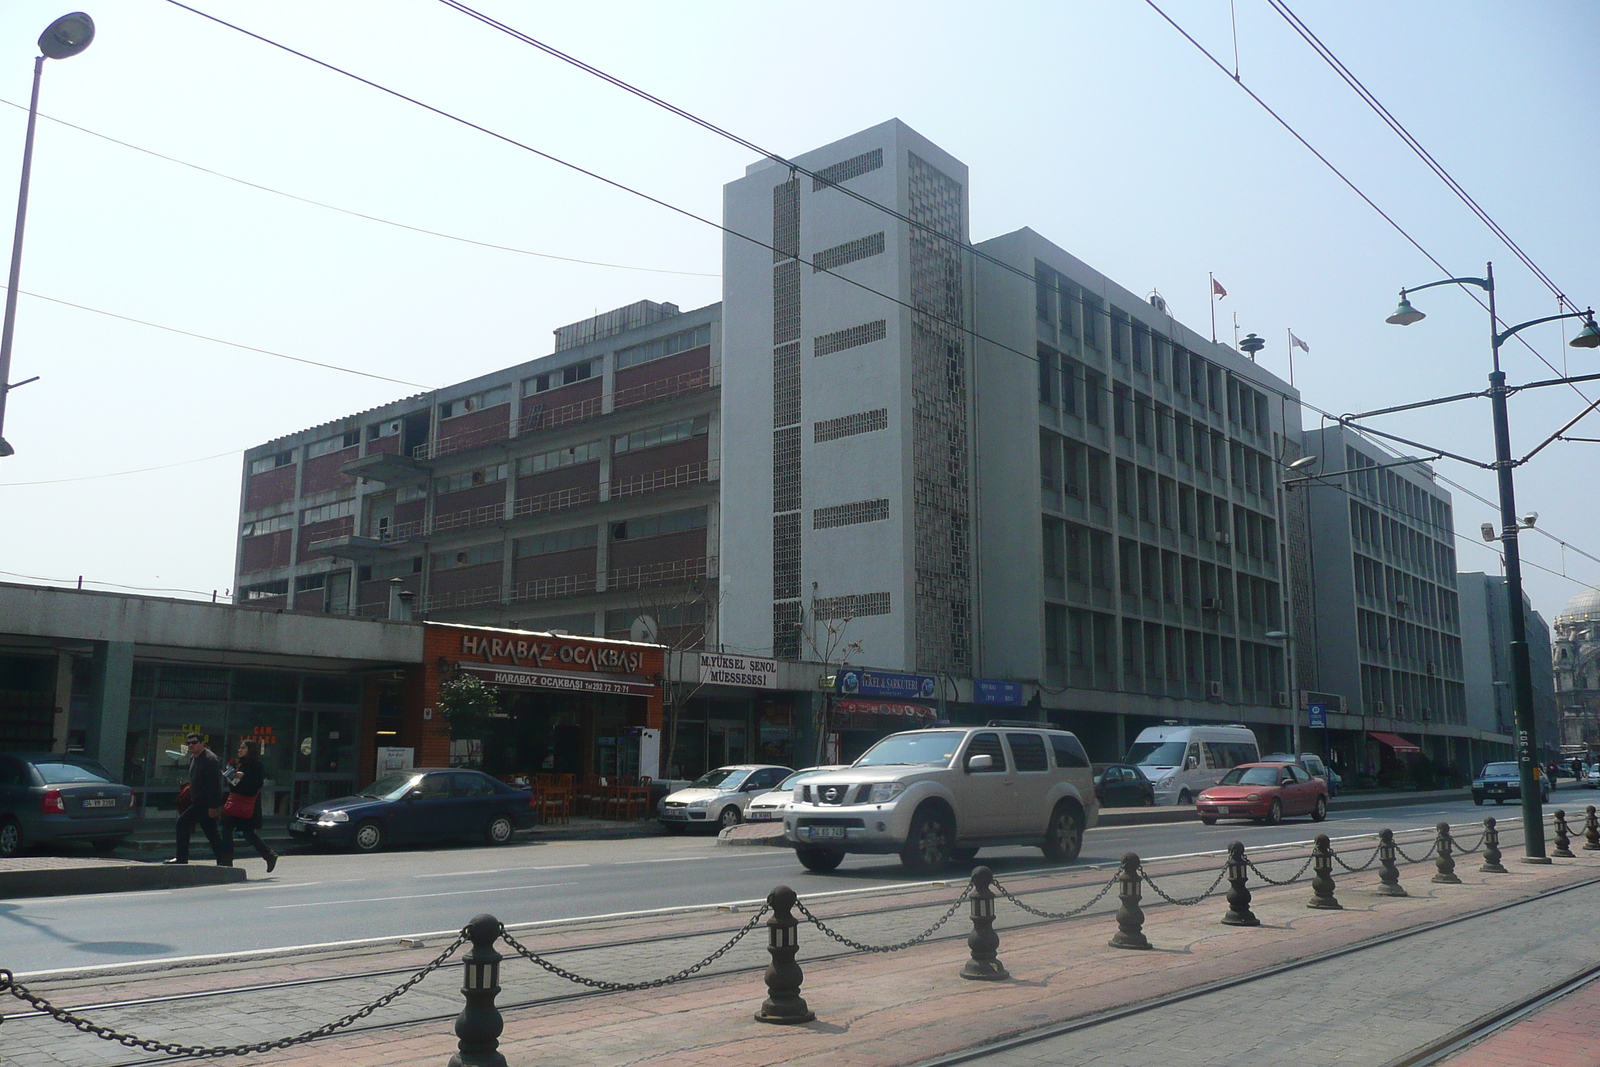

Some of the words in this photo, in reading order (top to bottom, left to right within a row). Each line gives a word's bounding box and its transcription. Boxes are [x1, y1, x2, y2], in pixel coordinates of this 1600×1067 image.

[462, 635, 553, 667] HARABAZ
[559, 645, 643, 673] OCAKBAŞI
[749, 660, 776, 673] ŞENOL
[495, 672, 537, 685] HARABAZ
[540, 676, 583, 689] OCAKBAŞI
[592, 682, 603, 691] 292
[604, 683, 611, 692] 72
[710, 670, 767, 686] MÜESSESESİ
[253, 726, 272, 735] CAM
